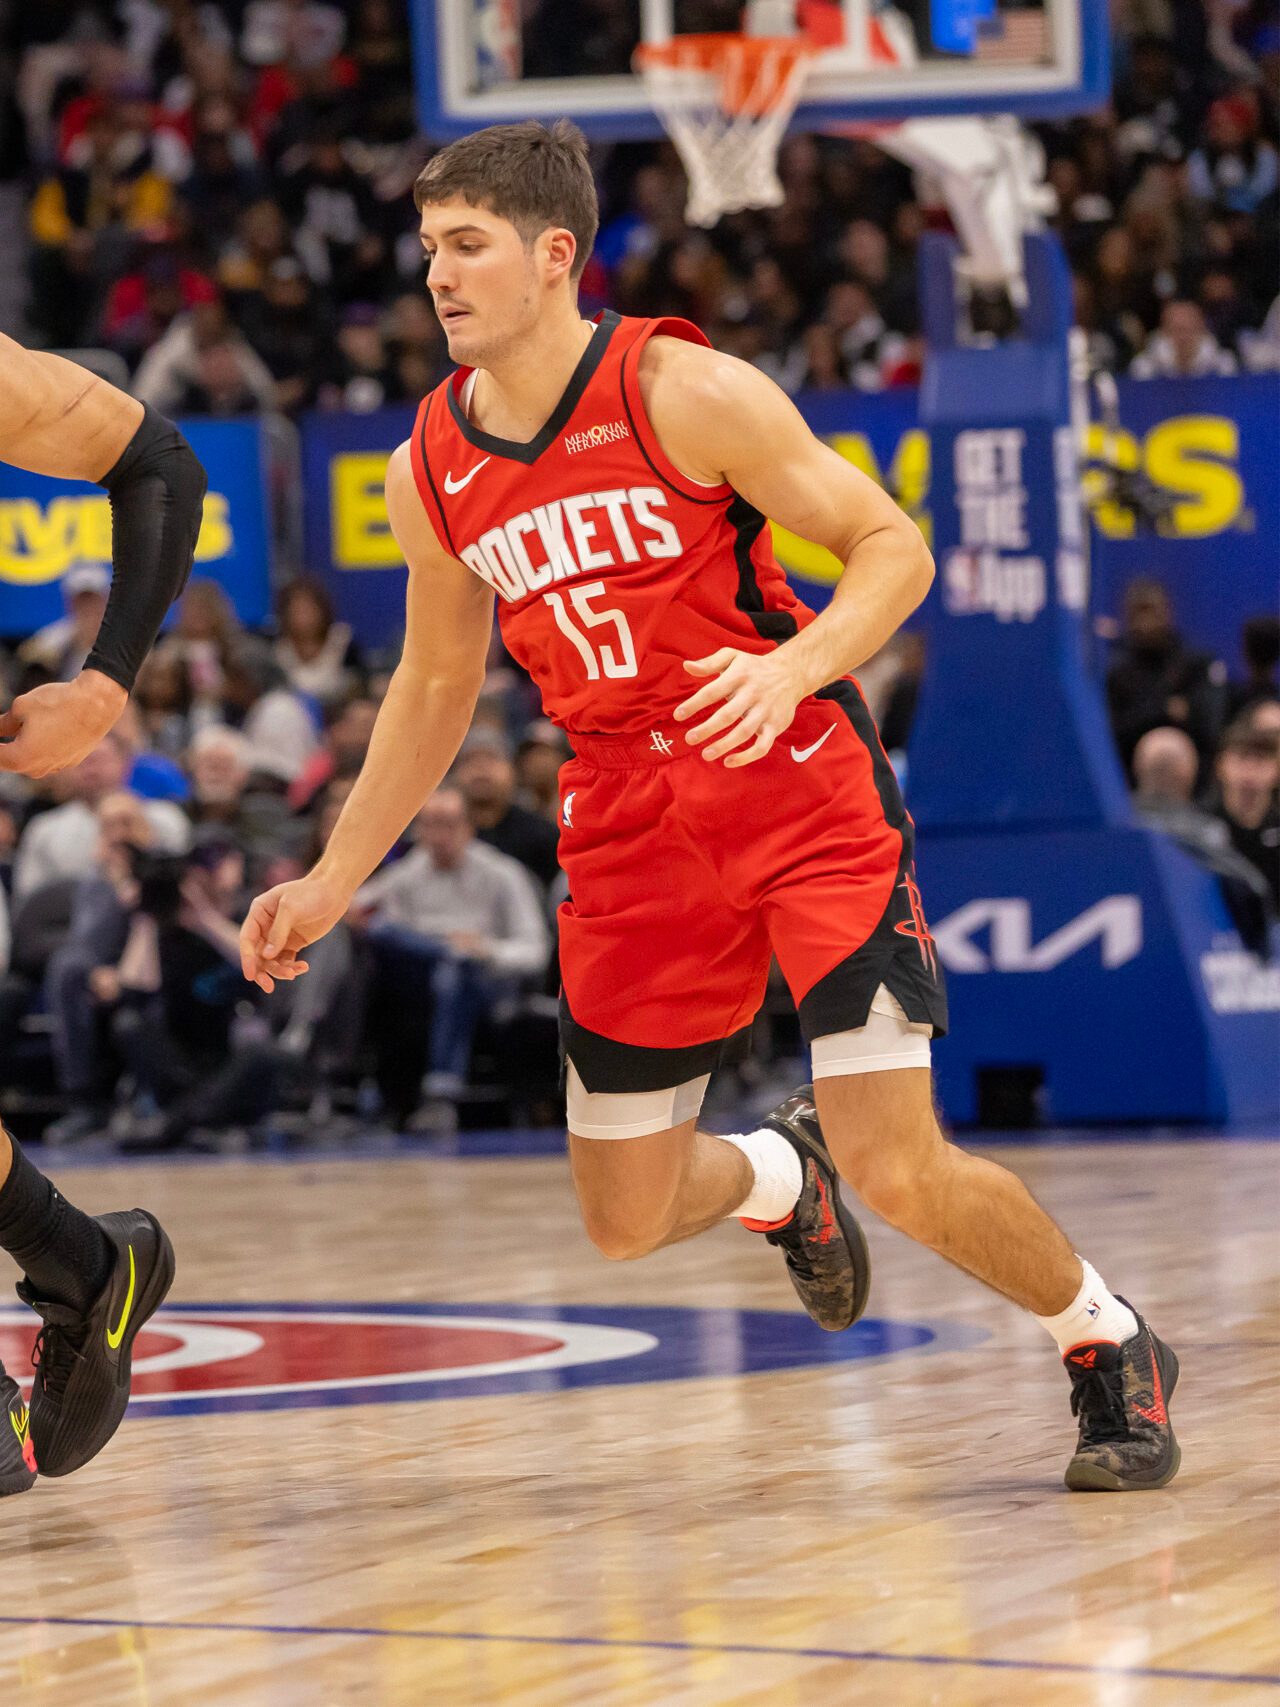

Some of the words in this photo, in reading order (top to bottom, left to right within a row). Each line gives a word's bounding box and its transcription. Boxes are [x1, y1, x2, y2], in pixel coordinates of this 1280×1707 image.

[564, 420, 629, 448] MEMORIAL
[566, 426, 630, 455] HERMANN
[459, 486, 684, 604] ROCKETS
[542, 580, 638, 680] 15
